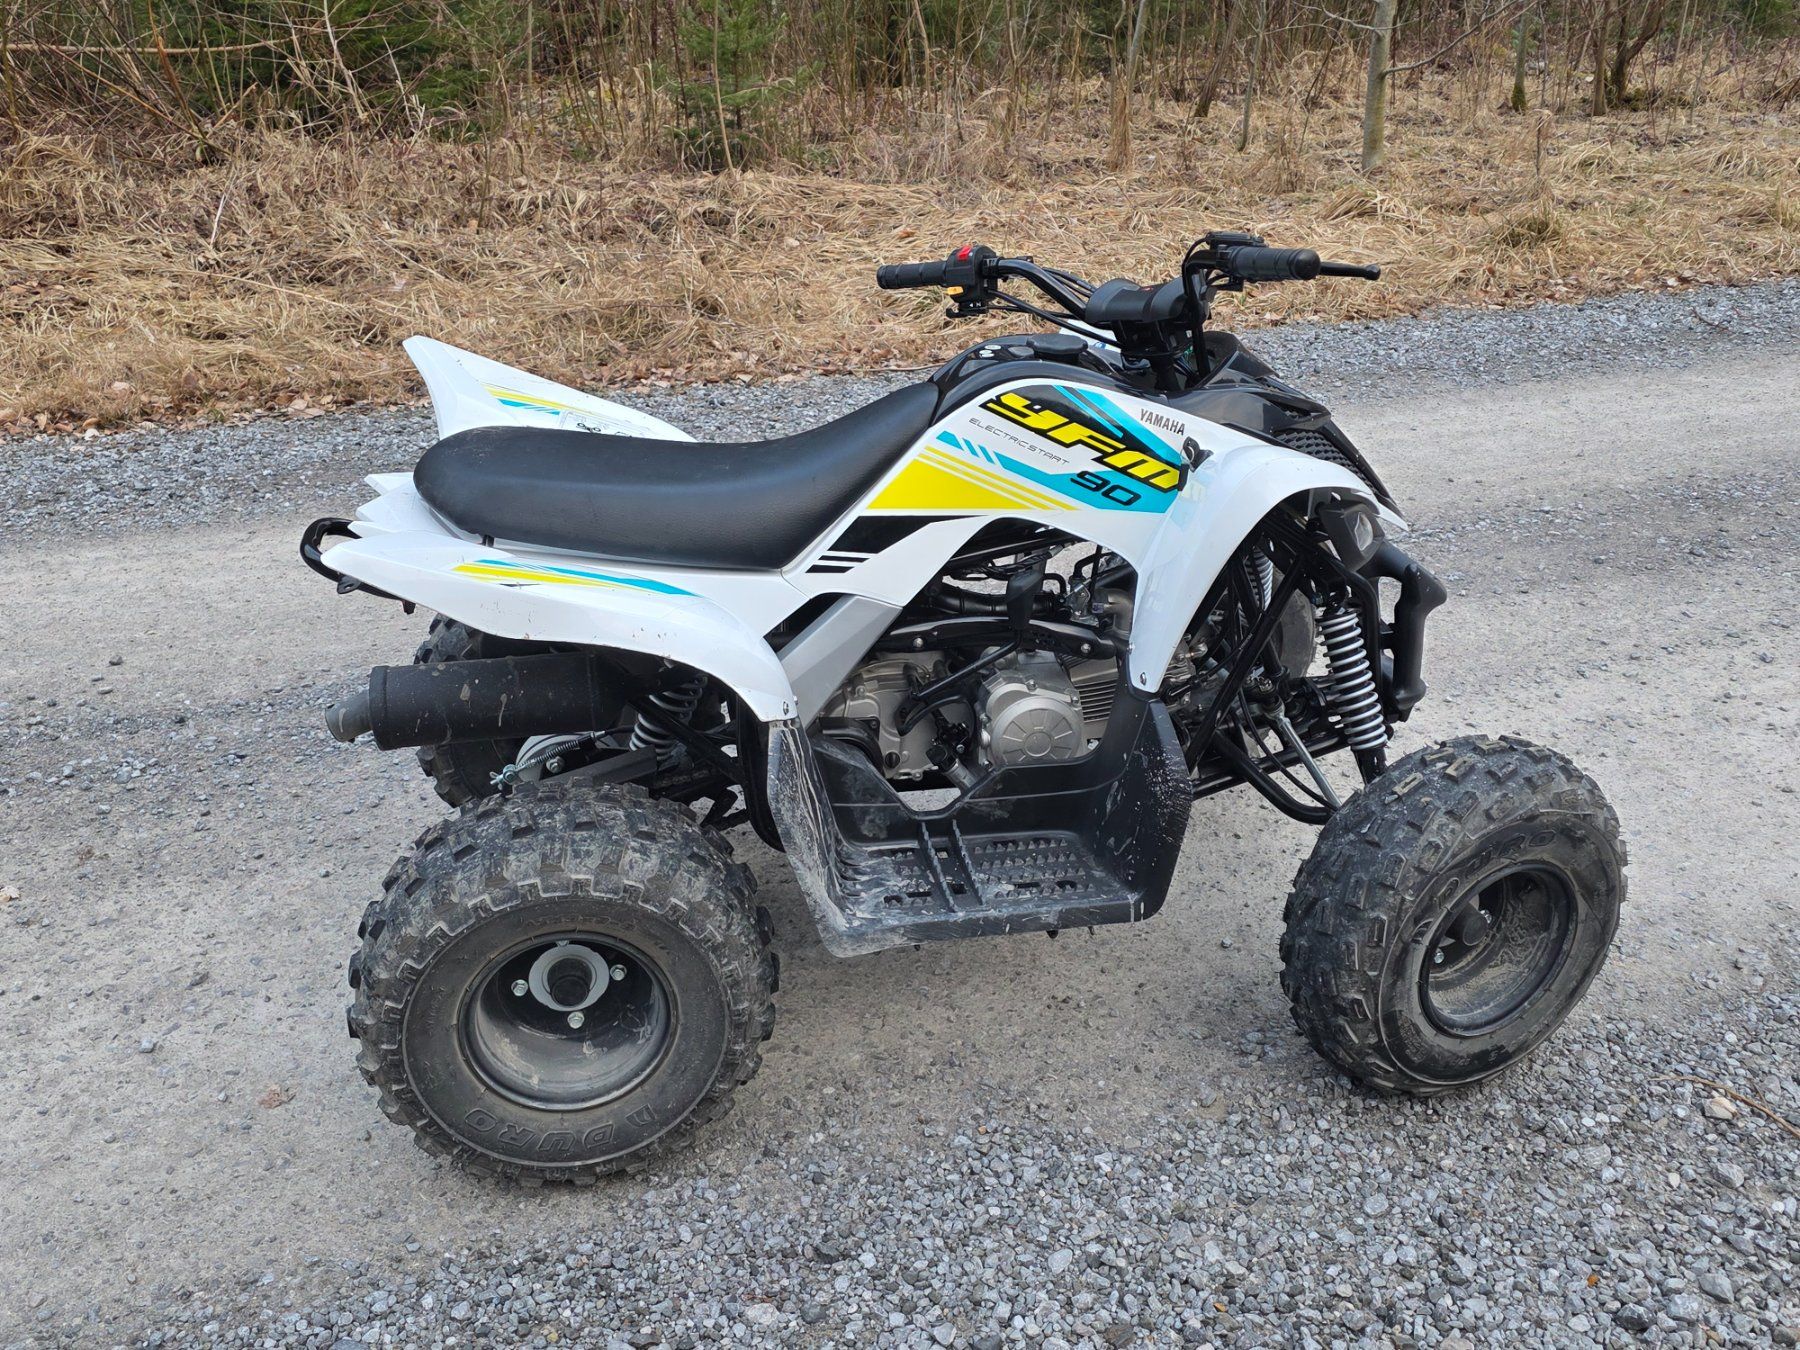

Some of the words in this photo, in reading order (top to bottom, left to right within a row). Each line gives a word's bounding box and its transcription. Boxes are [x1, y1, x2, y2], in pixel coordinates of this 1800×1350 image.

[1140, 408, 1186, 436] YAMAHA
[1069, 470, 1142, 506] 90
[463, 1107, 616, 1151] DURO
